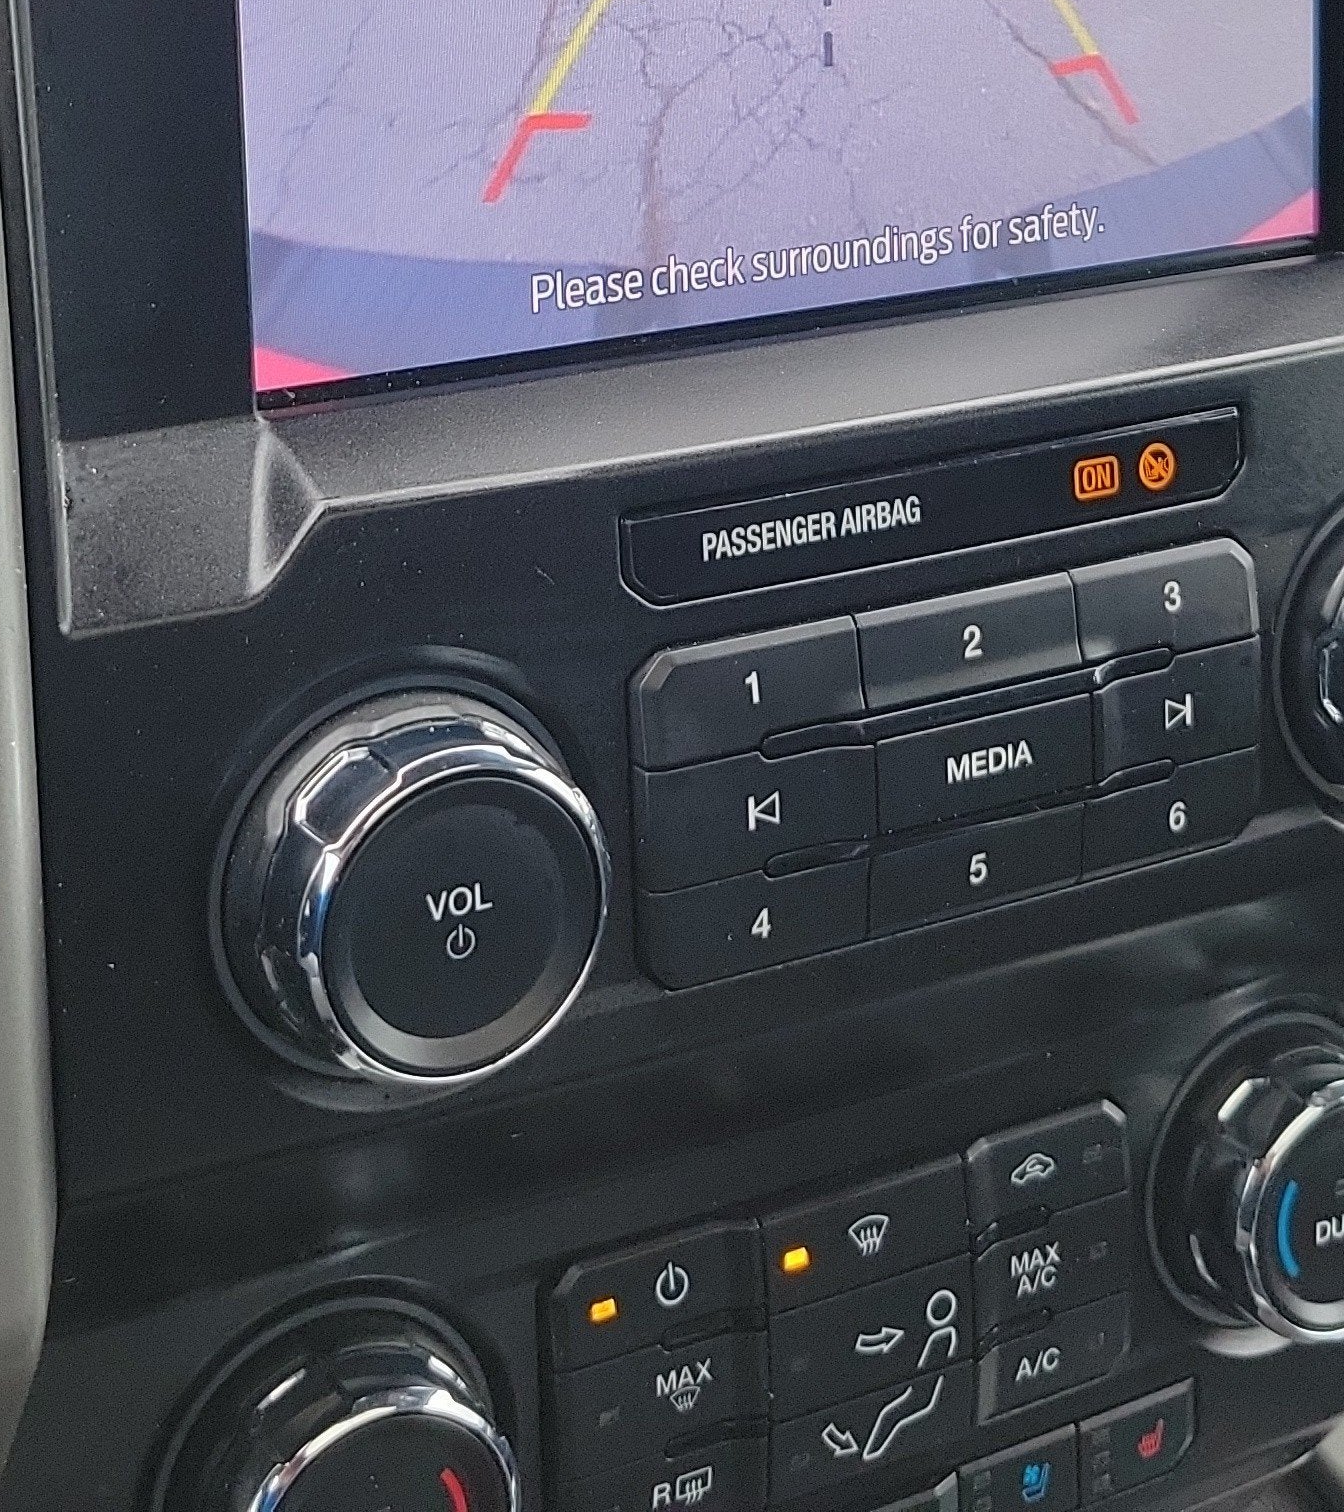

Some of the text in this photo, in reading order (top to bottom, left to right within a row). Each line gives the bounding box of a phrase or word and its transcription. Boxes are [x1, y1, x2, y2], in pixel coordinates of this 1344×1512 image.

[531, 203, 1106, 314] Please check surroundings for safety.
[1082, 460, 1115, 495] ON
[701, 494, 922, 563] PASSENGER AIRBAG
[1163, 580, 1183, 613] 3
[962, 624, 983, 659] 2
[744, 670, 761, 705] 1
[946, 738, 1034, 785] MEDIA
[1167, 800, 1187, 833] 6
[968, 852, 989, 885] 5
[425, 882, 493, 922] VOL
[751, 907, 772, 939] 4
[1009, 1241, 1062, 1280] MAX
[1016, 1264, 1058, 1296] A/C
[655, 1356, 714, 1396] MAX
[1014, 1346, 1061, 1383] A/C
[652, 1480, 672, 1510] R
